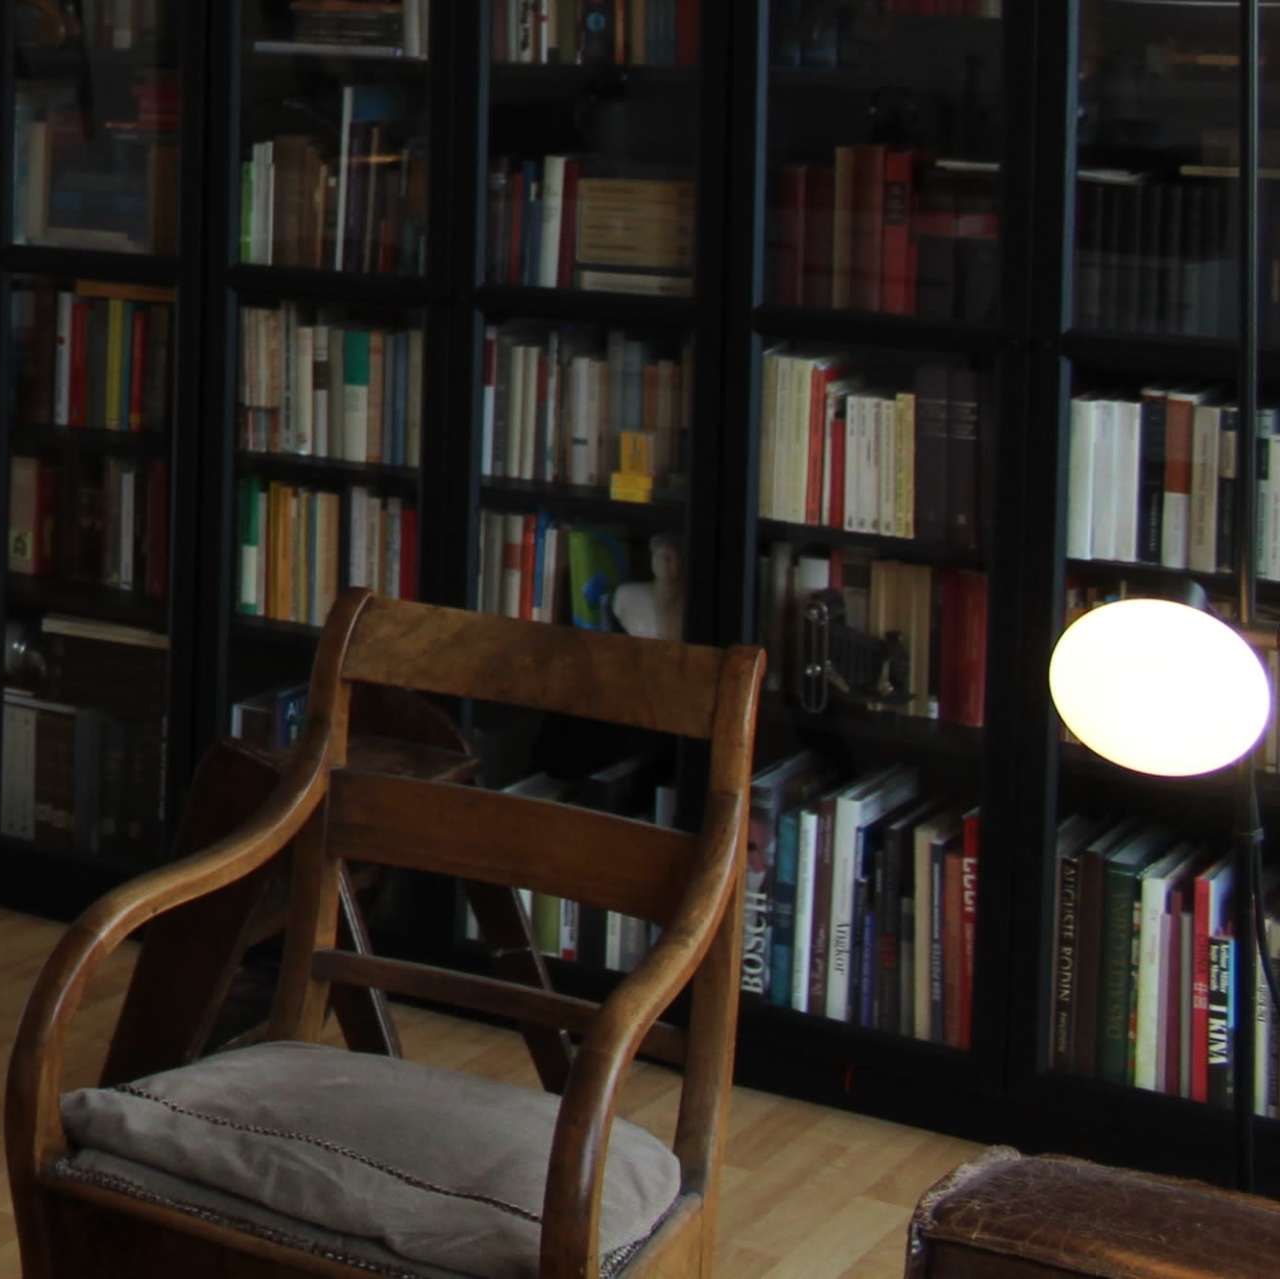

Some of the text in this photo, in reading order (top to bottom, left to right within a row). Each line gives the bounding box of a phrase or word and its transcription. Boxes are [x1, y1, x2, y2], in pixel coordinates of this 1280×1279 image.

[1062, 866, 1078, 939] AUGUSTE
[742, 892, 768, 994] BOSCH
[834, 922, 851, 975] Angkor
[1056, 946, 1073, 1003] RODIN
[1208, 1017, 1228, 1065] KINA
